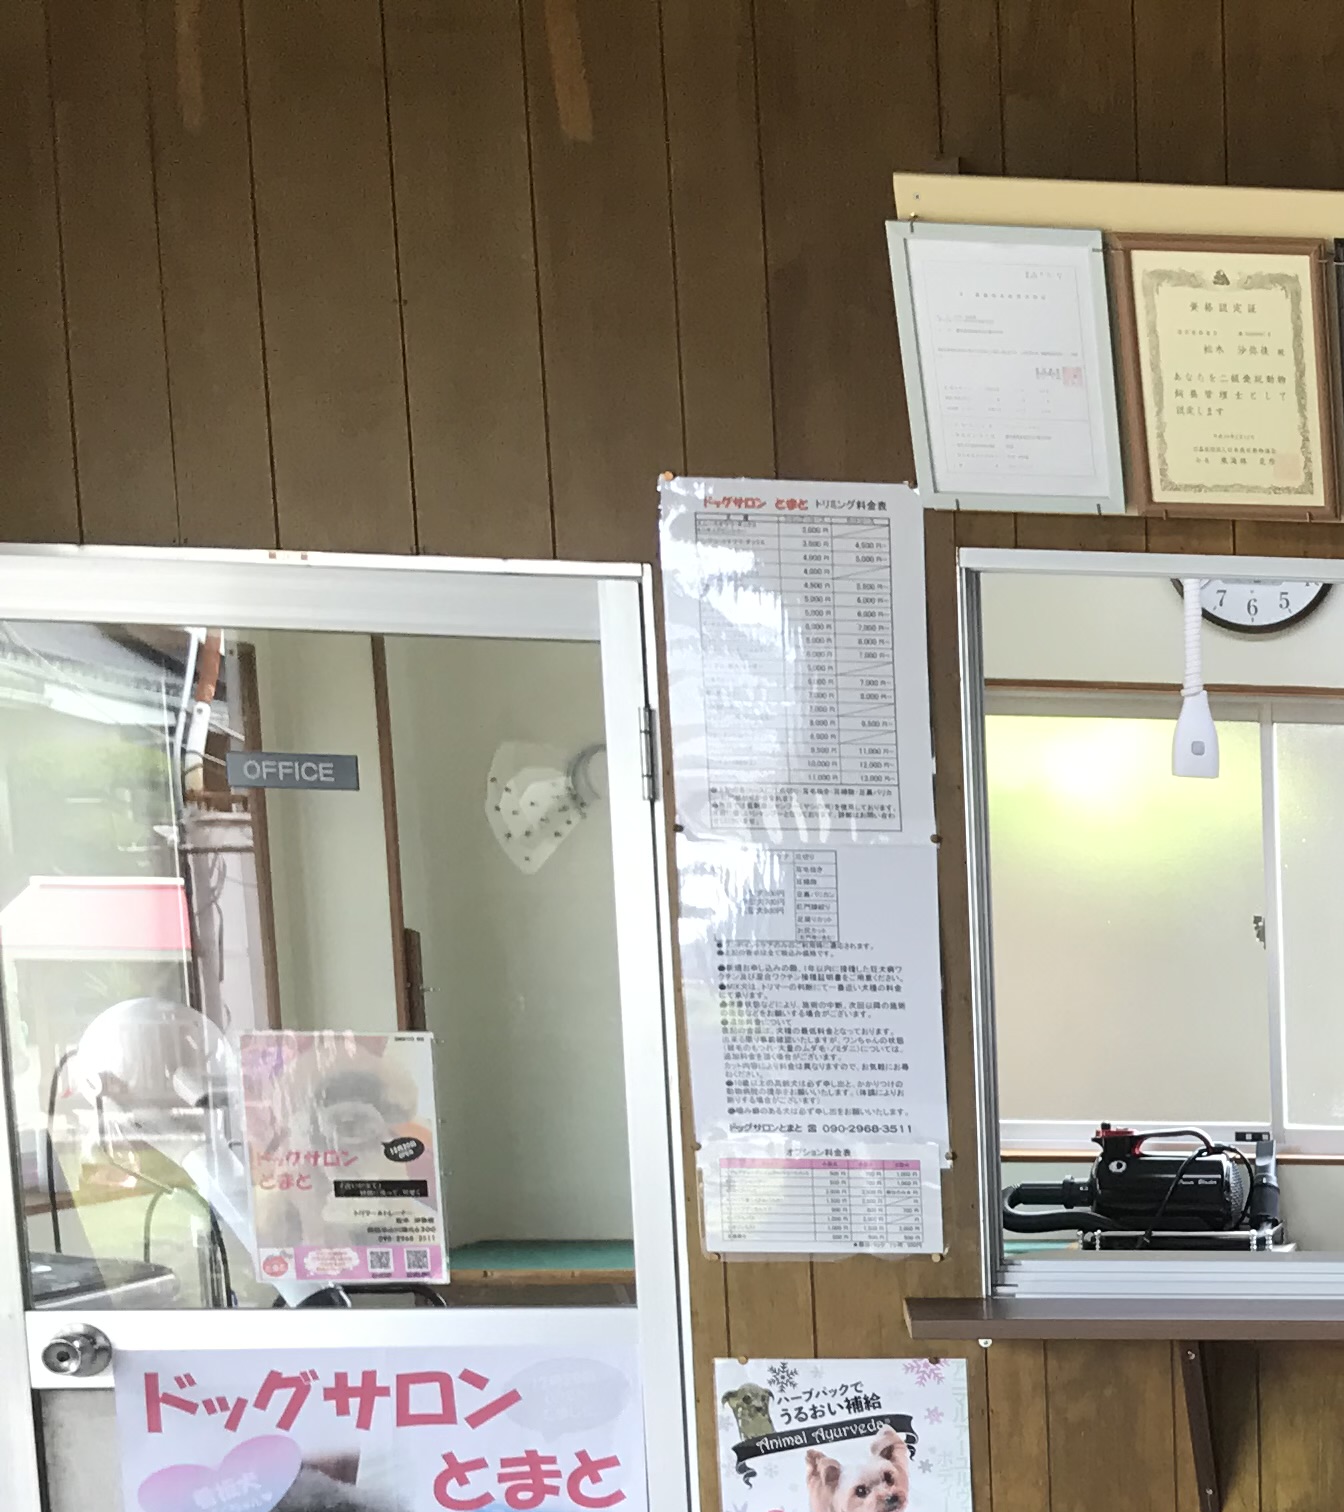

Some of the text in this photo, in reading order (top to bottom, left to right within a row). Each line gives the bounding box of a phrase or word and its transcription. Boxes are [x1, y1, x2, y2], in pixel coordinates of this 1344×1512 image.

[1215, 589, 1228, 608] 7
[1246, 598, 1259, 617] 6
[1278, 591, 1290, 610] 5
[242, 759, 336, 784] OFFICE
[822, 1123, 913, 1134] 090-2968-3511
[143, 1368, 523, 1434] ドッグサロン
[779, 1393, 883, 1426] うるおい補給
[754, 1431, 809, 1455] Animal
[432, 1448, 627, 1512] とまと
